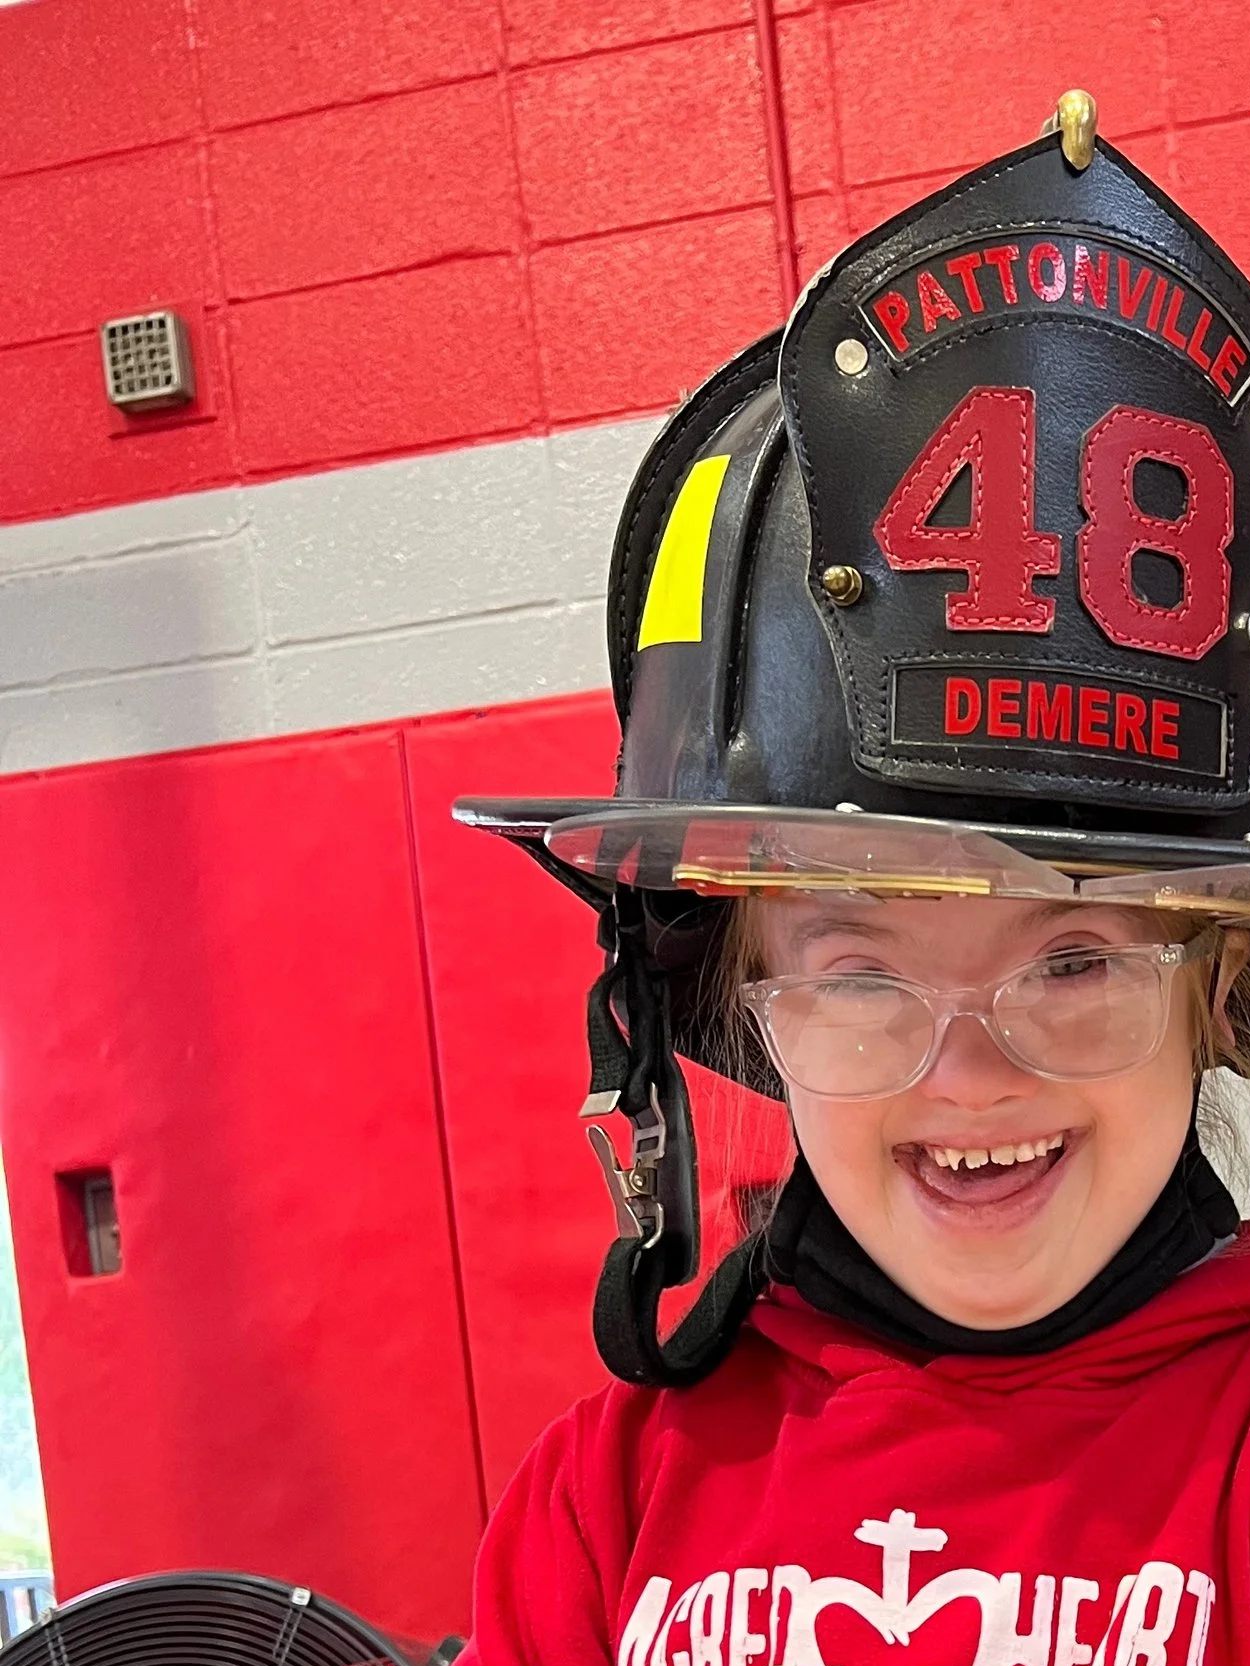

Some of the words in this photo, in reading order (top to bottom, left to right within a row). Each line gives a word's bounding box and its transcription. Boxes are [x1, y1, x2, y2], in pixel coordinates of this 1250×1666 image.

[873, 242, 1247, 396] PATTONVILLE
[873, 385, 1235, 660] 48
[944, 676, 1181, 760] DEMERE
